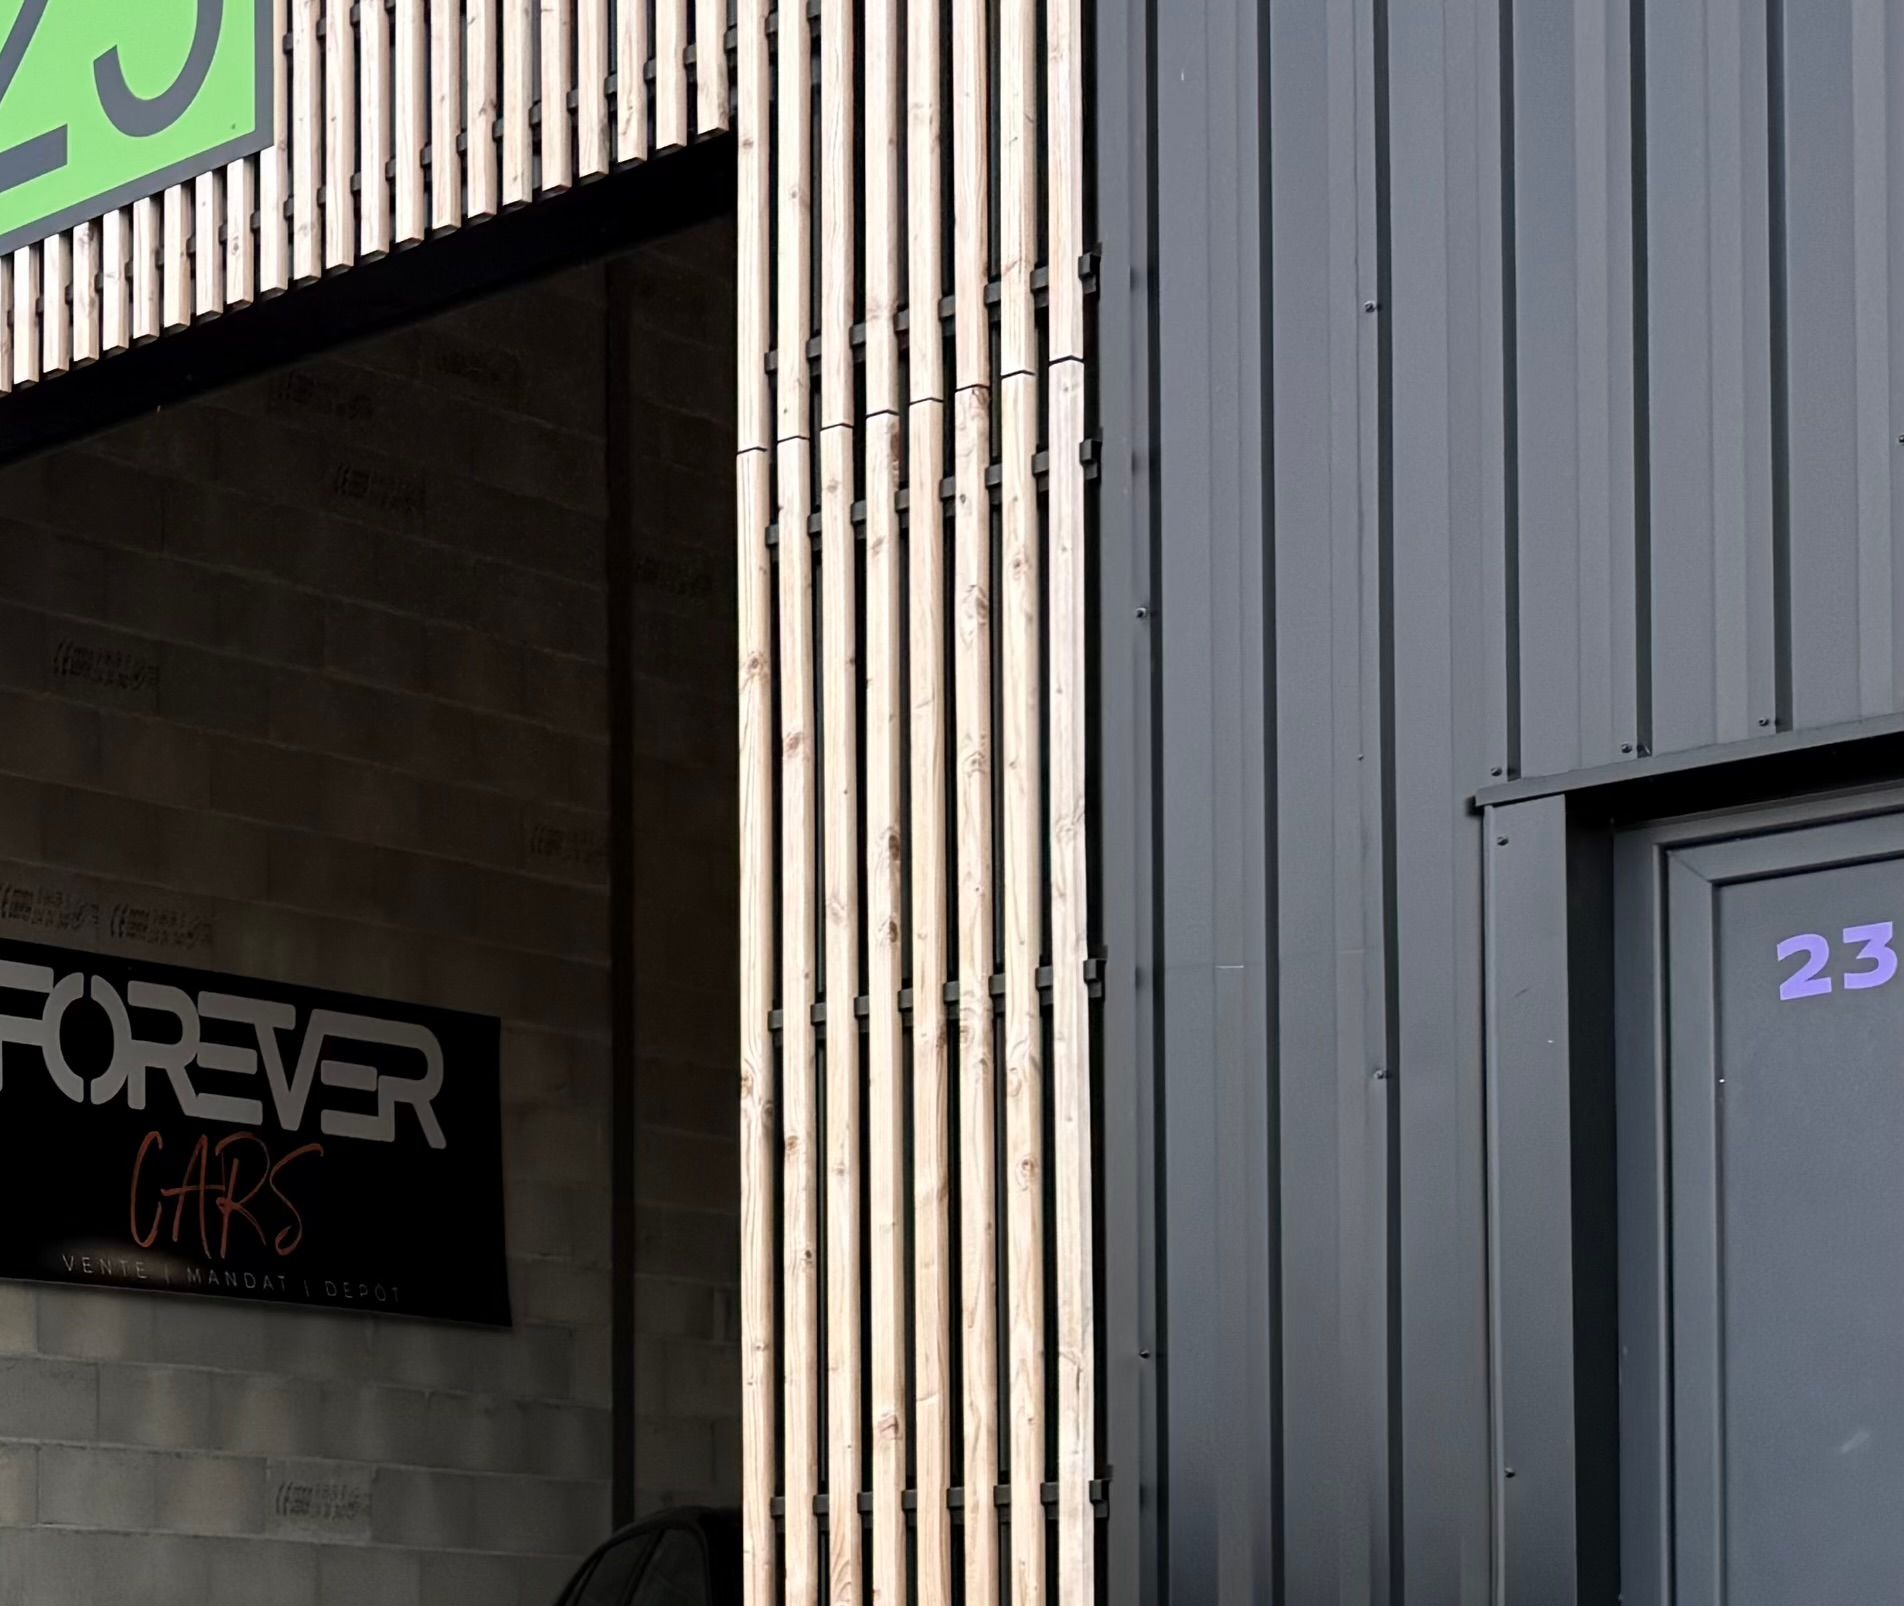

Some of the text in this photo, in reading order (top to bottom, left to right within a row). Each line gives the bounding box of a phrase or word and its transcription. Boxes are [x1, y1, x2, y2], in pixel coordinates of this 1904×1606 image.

[1776, 920, 1899, 1001] 23
[129, 1130, 324, 1259] CARS
[61, 1252, 149, 1281] VENTE
[186, 1265, 287, 1293] MANDAT
